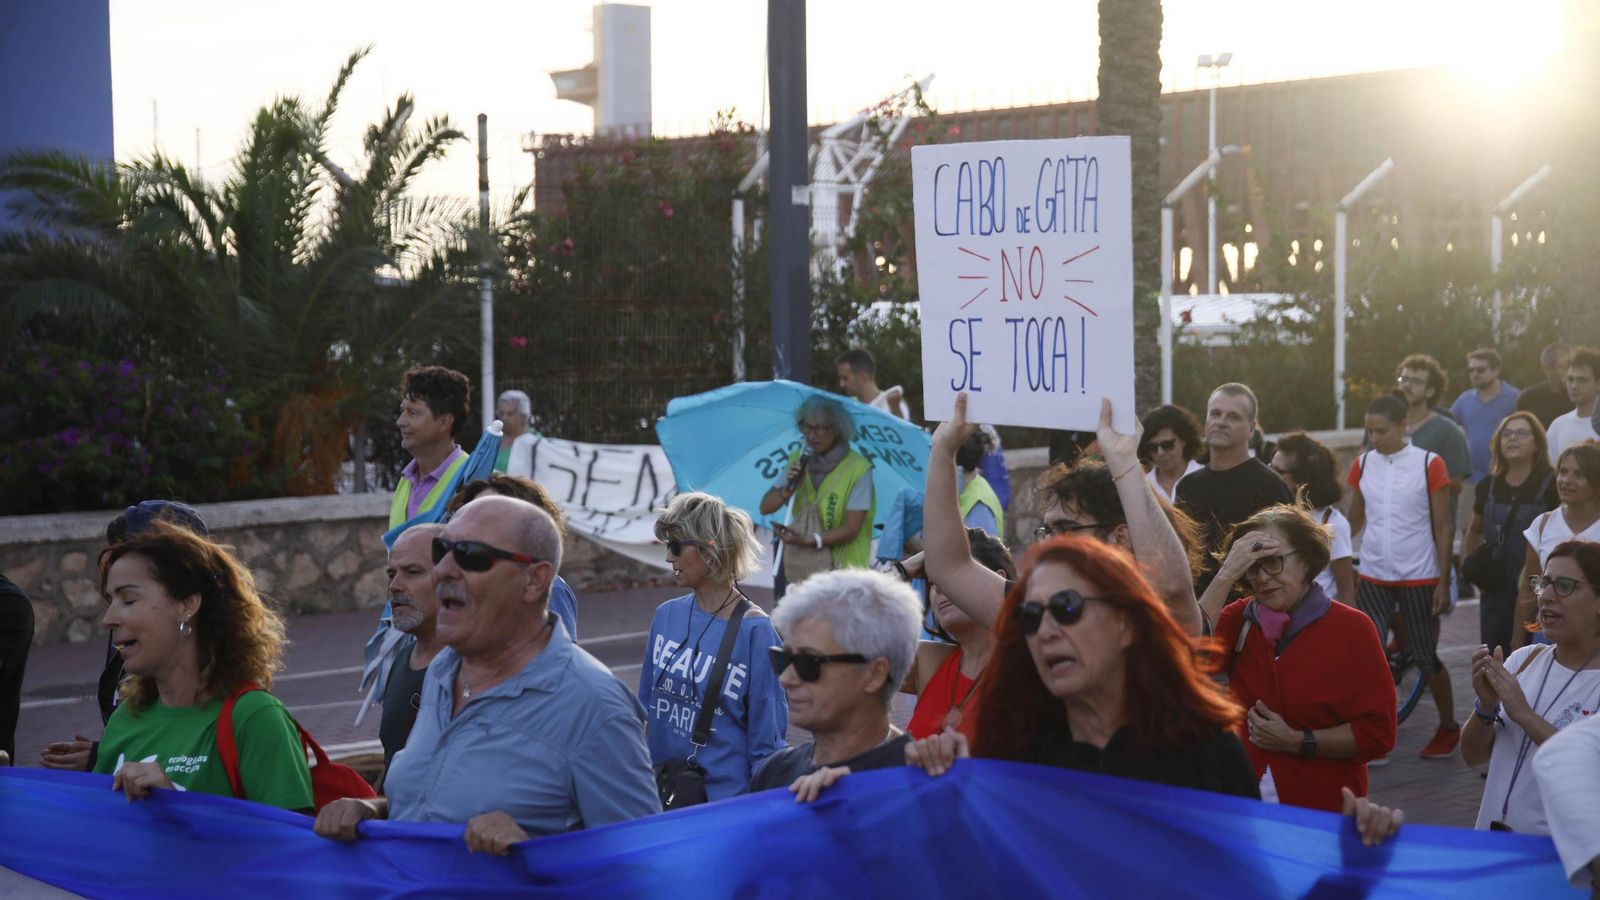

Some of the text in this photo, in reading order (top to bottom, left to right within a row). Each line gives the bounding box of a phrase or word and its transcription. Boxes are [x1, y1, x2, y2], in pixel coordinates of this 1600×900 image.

[934, 157, 1006, 236] CABO
[1035, 155, 1099, 234] GATA
[1000, 245, 1044, 302] NO
[949, 317, 983, 392] SE
[652, 634, 748, 701] BEAUÉ
